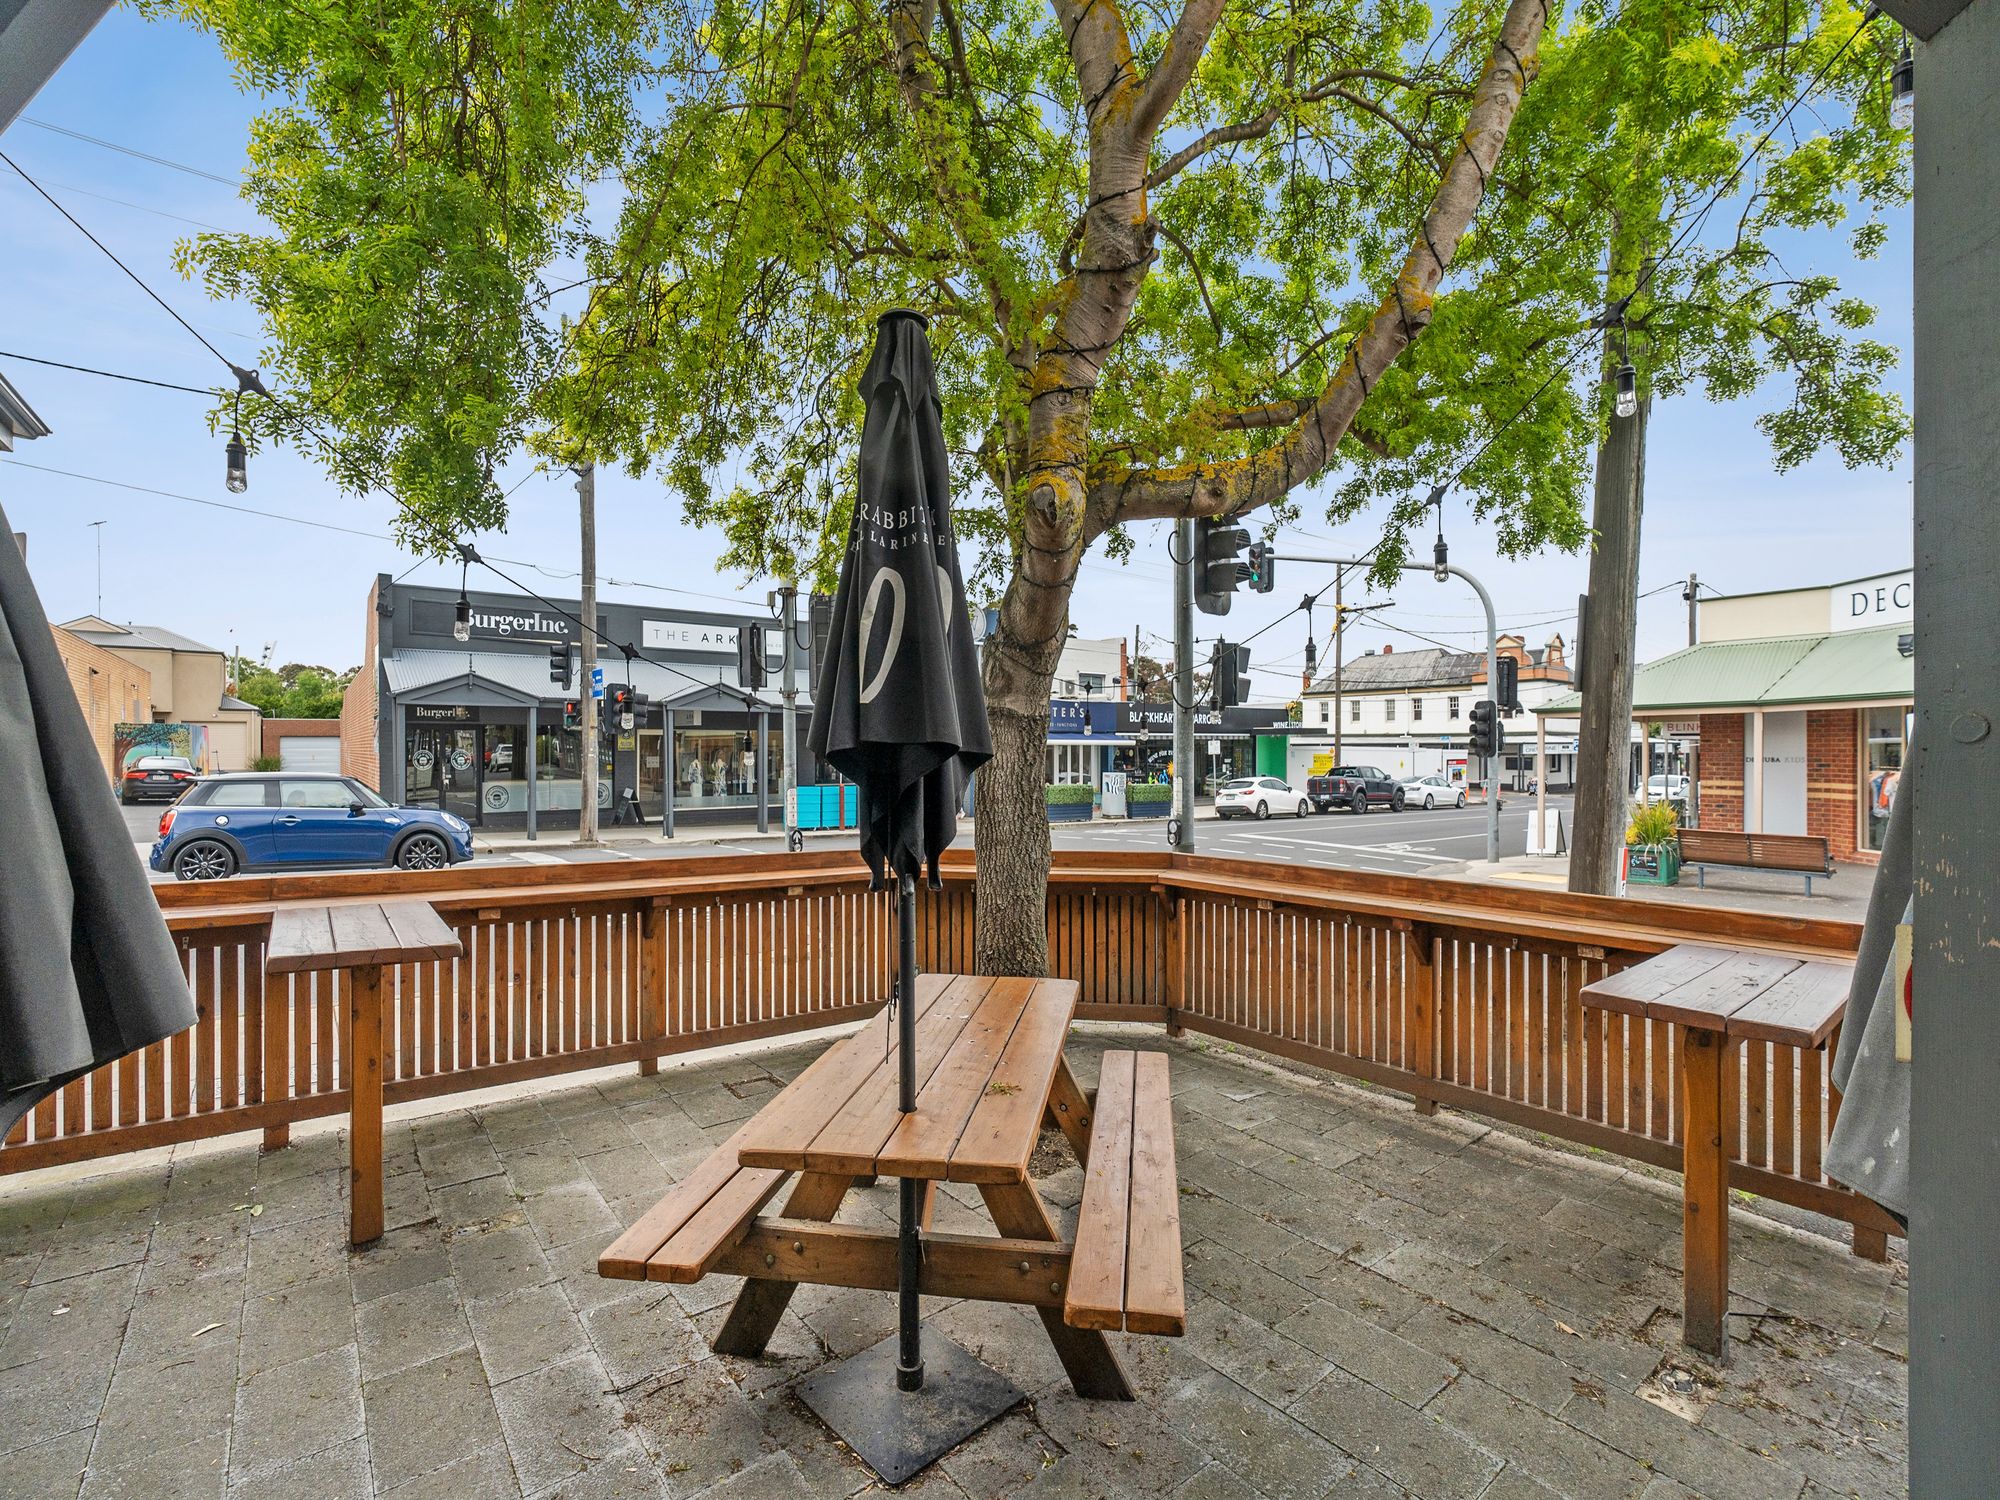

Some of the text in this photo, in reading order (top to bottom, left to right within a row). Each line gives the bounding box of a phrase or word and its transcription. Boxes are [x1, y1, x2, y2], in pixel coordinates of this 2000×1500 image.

[1851, 583, 1911, 616] DEC
[653, 629, 736, 645] THE ARK
[416, 706, 470, 719] BurgerI.
